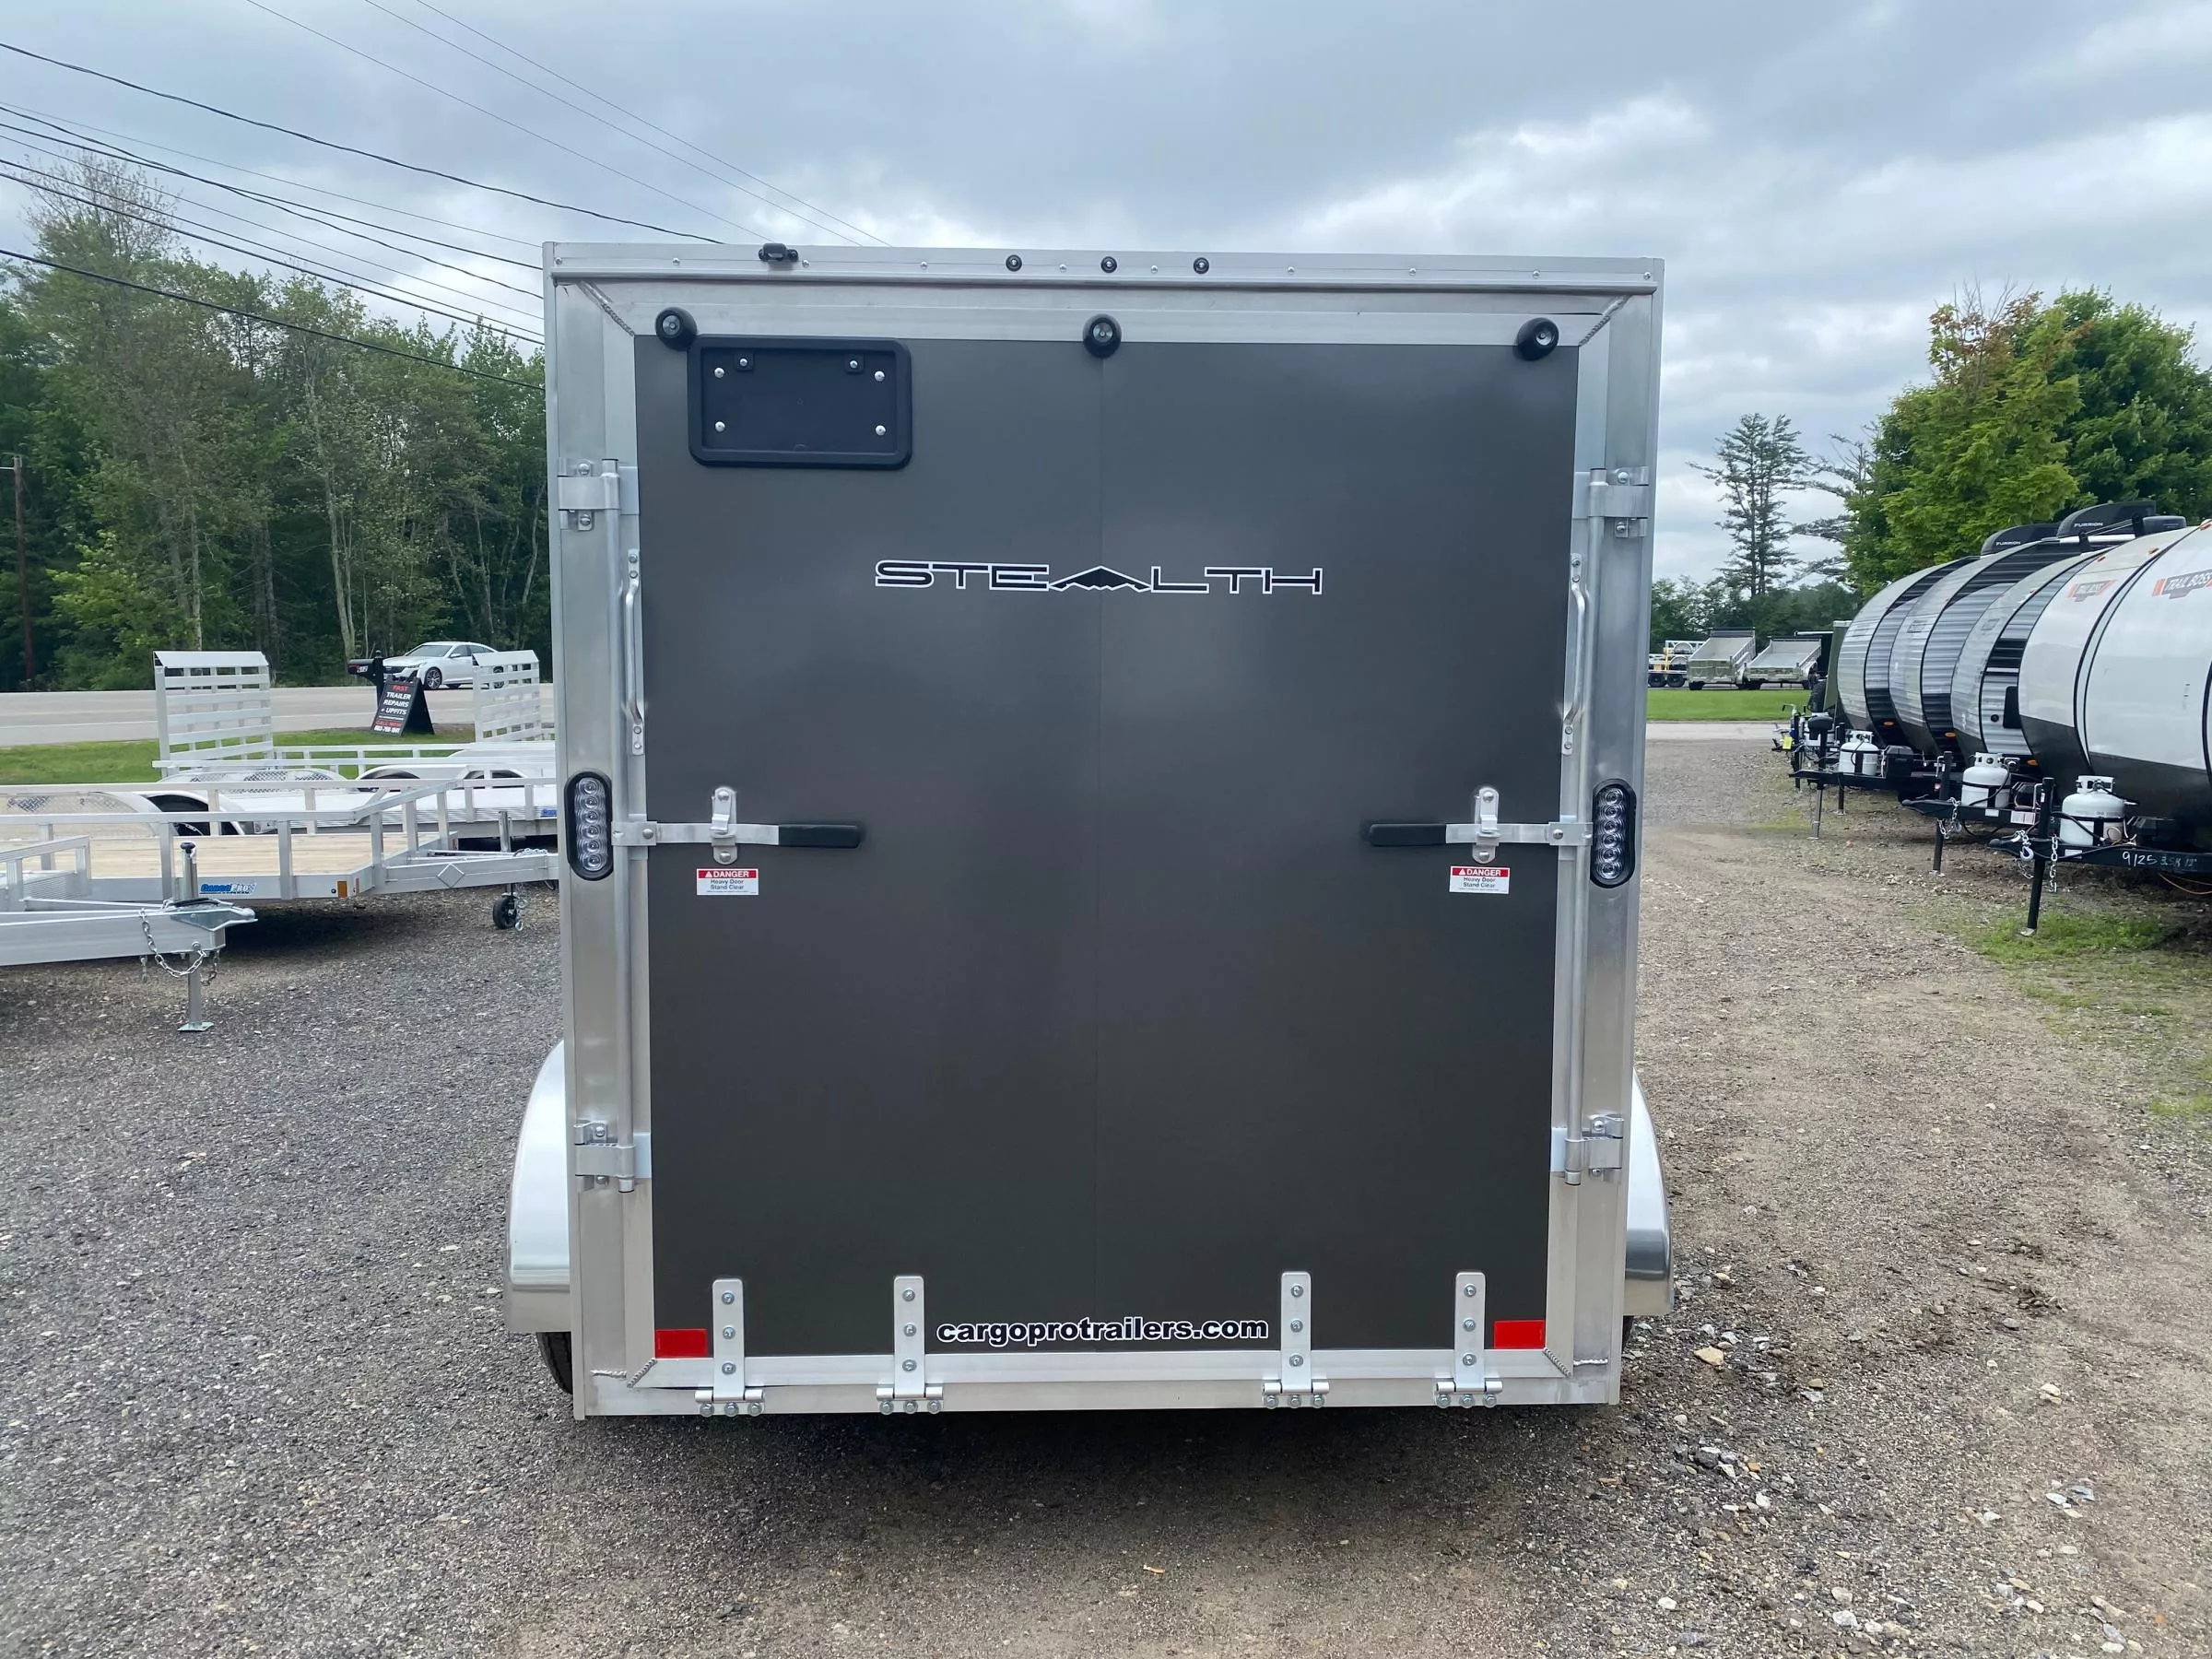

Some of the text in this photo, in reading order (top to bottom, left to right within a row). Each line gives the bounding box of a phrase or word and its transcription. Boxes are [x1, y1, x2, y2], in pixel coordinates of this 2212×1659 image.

[875, 559, 1324, 595] STEALTH
[386, 691, 412, 700] TRAILER
[935, 1316, 1269, 1347] cargoprotrailers.com
